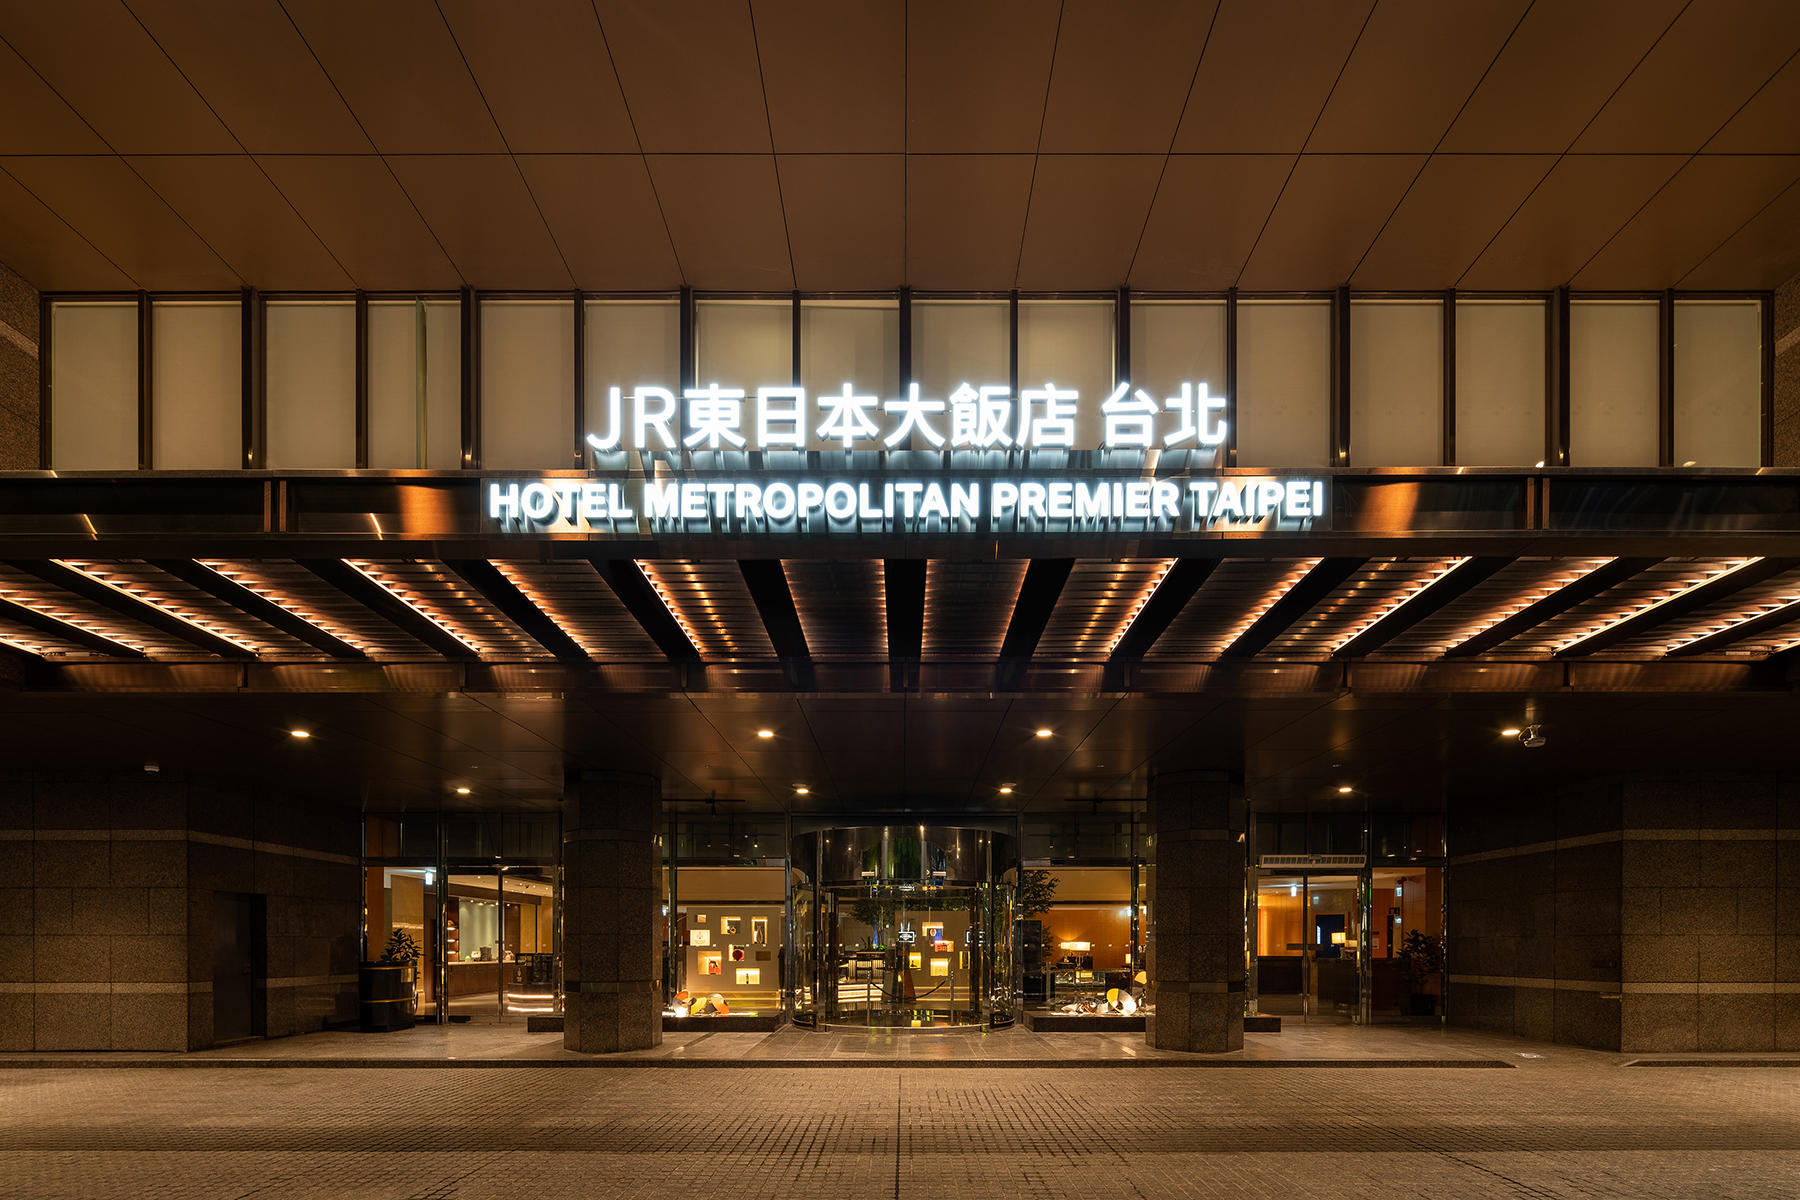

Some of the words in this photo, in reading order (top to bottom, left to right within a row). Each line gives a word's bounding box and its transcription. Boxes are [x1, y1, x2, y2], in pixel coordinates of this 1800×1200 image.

[586, 381, 1079, 452] JR東日本大飯店
[1101, 380, 1228, 449] 台北
[489, 481, 634, 521] HOTEL
[643, 481, 981, 521] METROPOLITAN
[989, 480, 1181, 520] PREMIER
[1188, 479, 1325, 518] TAIPEI
